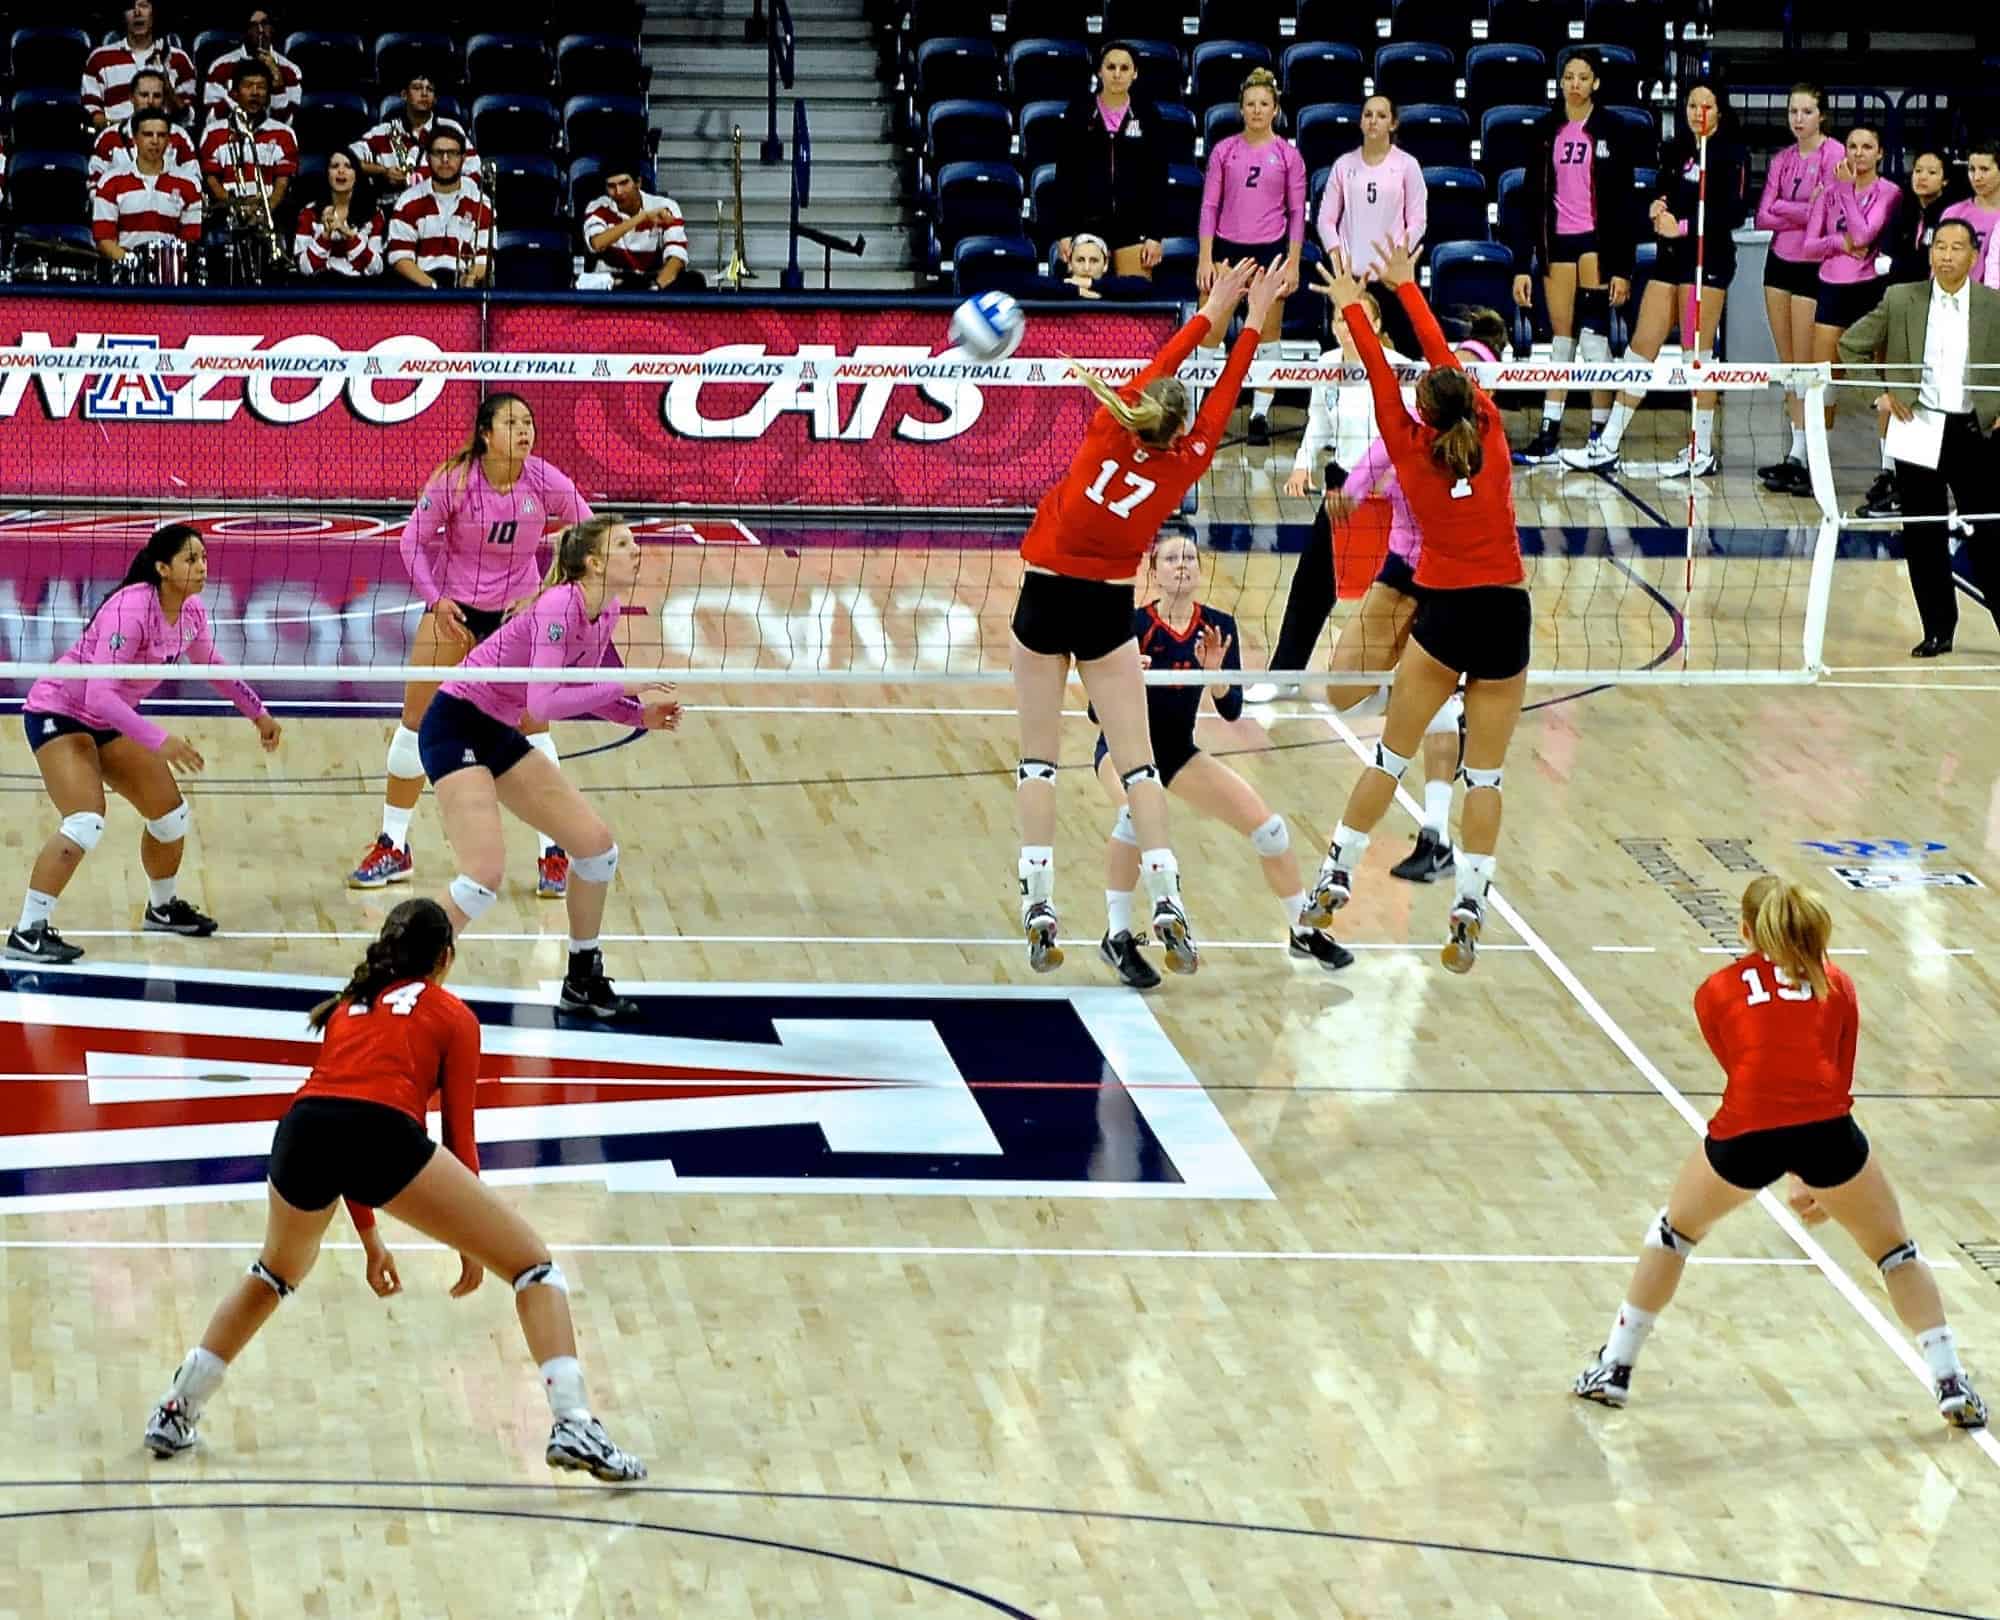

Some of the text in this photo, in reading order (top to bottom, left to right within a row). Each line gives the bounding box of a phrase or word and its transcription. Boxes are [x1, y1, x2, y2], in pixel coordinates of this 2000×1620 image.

[1560, 141, 1588, 165] 33
[1245, 166, 1261, 187] 2
[1366, 182, 1378, 204] 5
[1704, 370, 1770, 383] ARIZON
[662, 343, 985, 443] CATS
[1084, 459, 1157, 520] 17
[487, 520, 518, 545] 10
